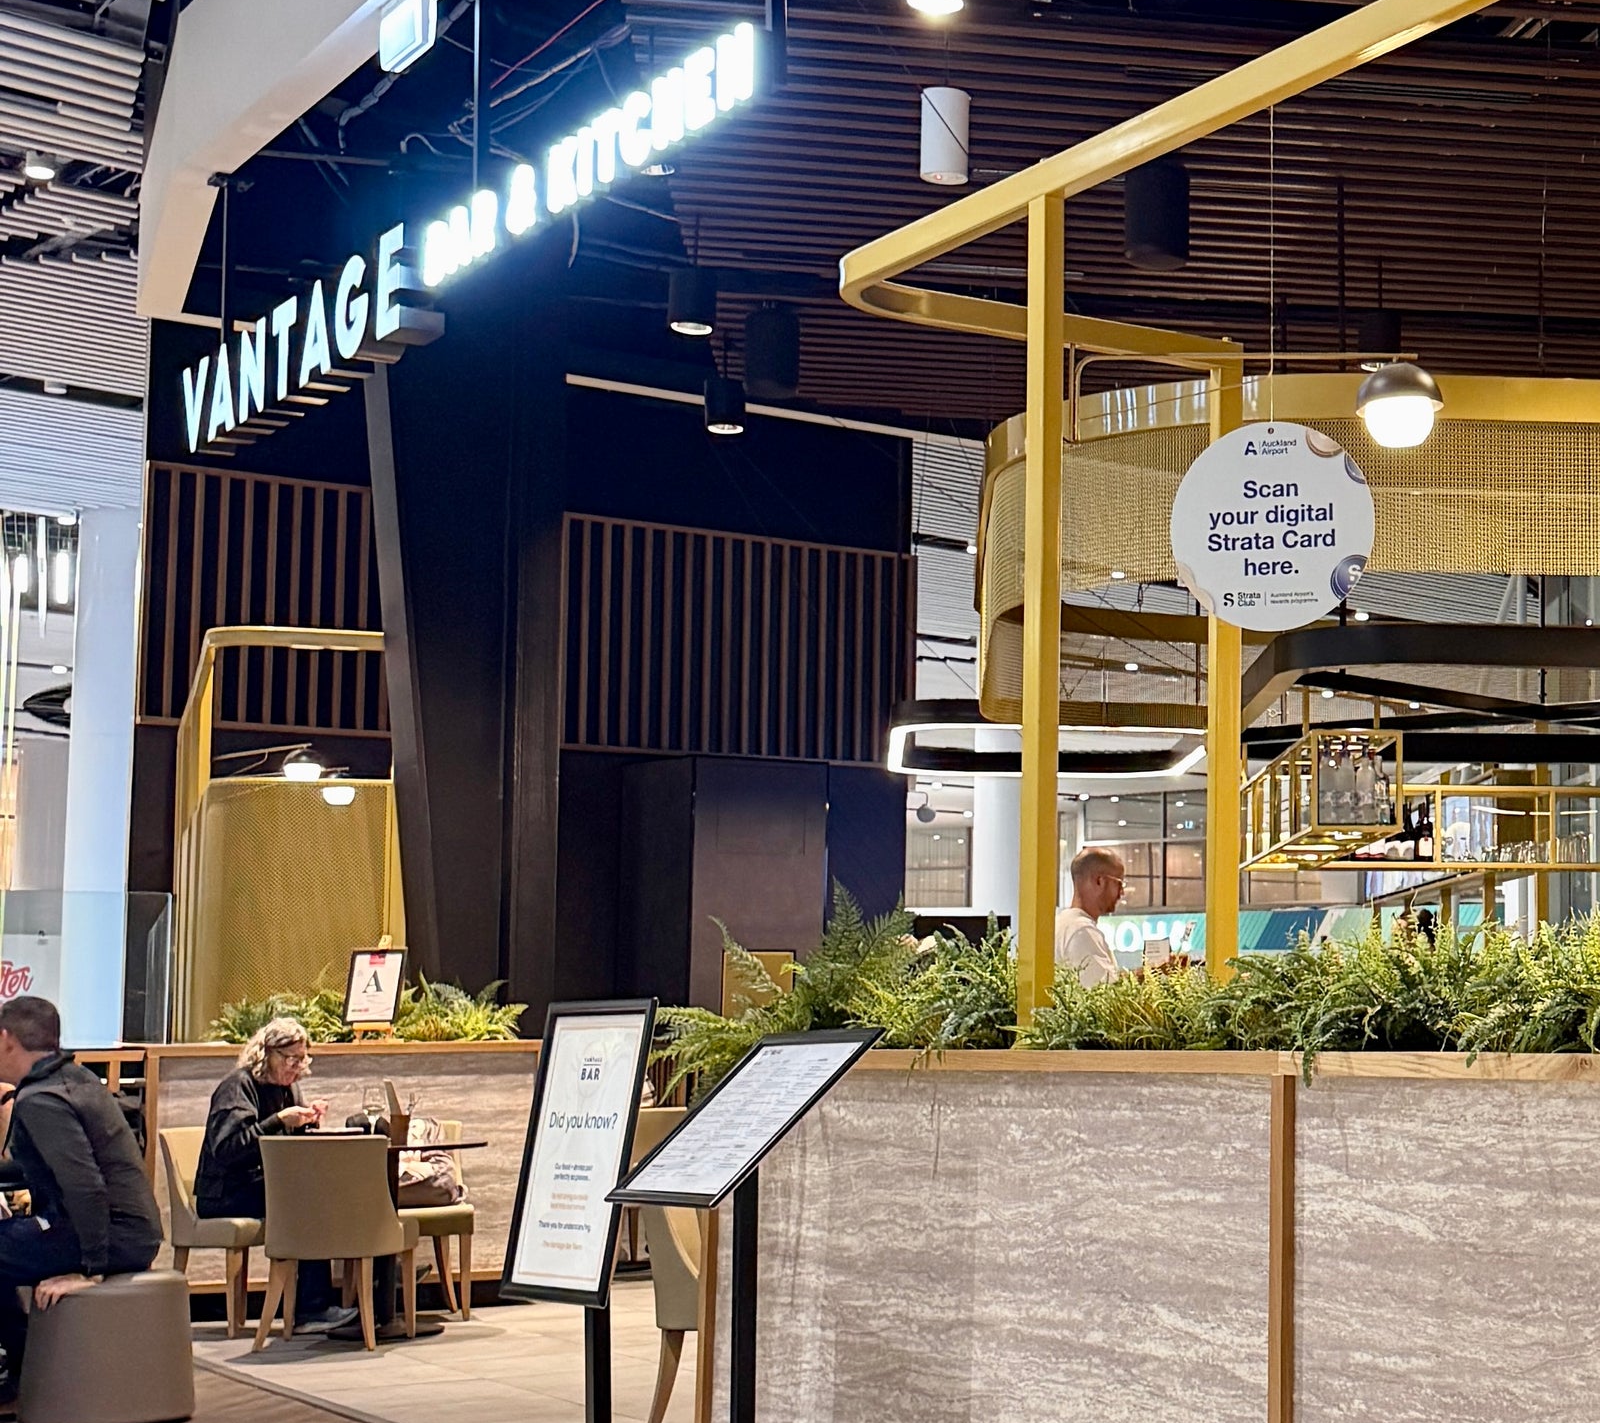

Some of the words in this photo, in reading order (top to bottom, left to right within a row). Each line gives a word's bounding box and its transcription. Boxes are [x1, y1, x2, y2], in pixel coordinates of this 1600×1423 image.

[182, 222, 404, 454] VANTAGE
[546, 22, 755, 214] KITCHEN
[1261, 439, 1297, 448] Auckland
[1261, 447, 1288, 456] Airport
[1243, 480, 1299, 499] Scan
[1209, 510, 1259, 531] your
[1265, 502, 1334, 527] digital
[1208, 533, 1275, 552] Strata
[1282, 528, 1336, 549] Card
[1244, 558, 1299, 576] here.
[1237, 591, 1261, 599] Strata
[1237, 598, 1256, 607] Club
[362, 969, 383, 994] A
[580, 1067, 601, 1081] BAR
[549, 1111, 566, 1128] Did
[566, 1114, 583, 1133] you
[584, 1112, 618, 1129] know?
